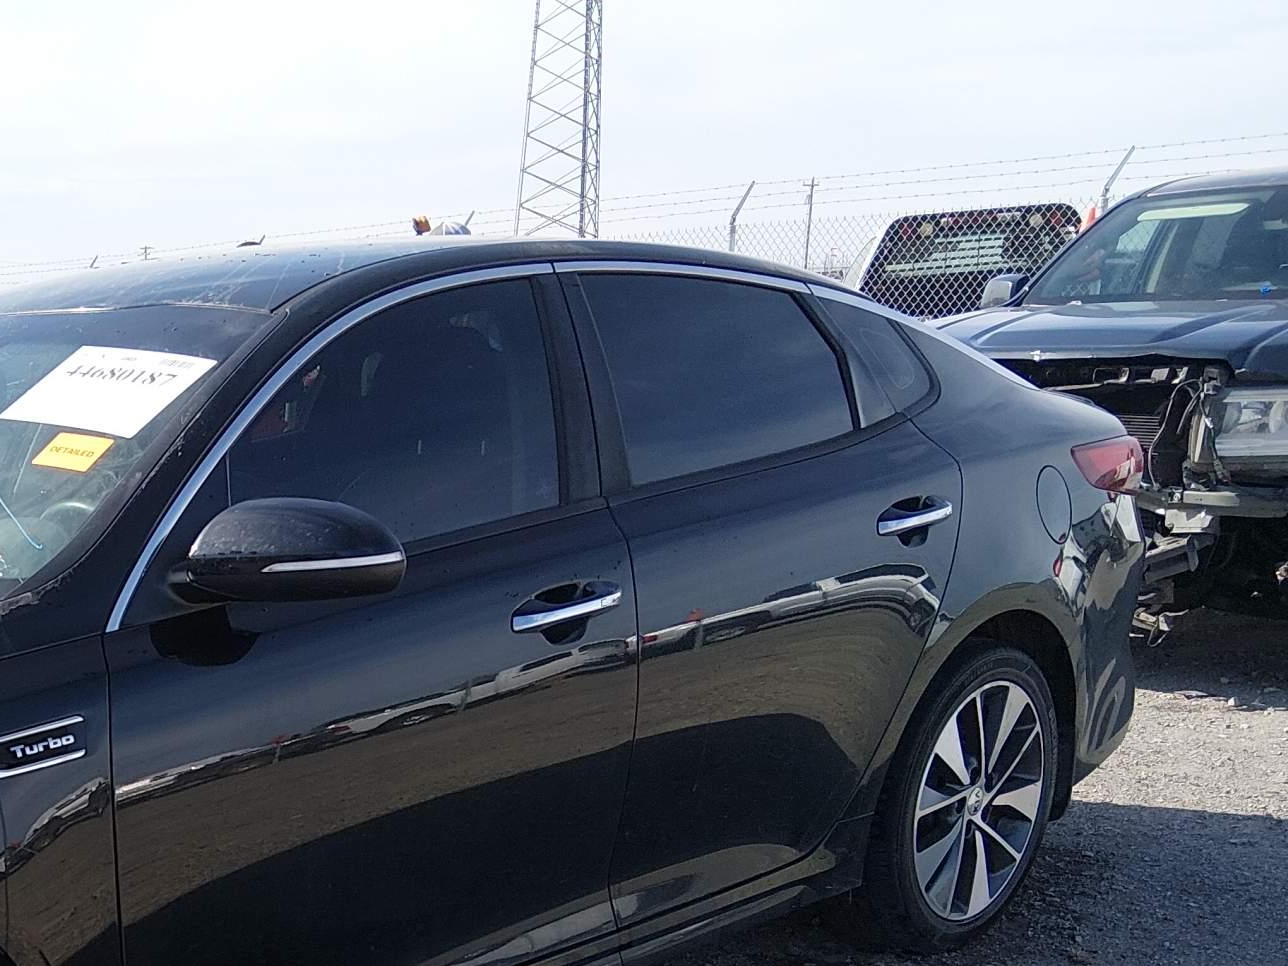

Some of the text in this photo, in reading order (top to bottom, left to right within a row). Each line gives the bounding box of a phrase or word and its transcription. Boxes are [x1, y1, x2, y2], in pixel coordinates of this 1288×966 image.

[66, 365, 178, 385] 44680187
[50, 446, 94, 457] DETAILED
[10, 735, 75, 758] Turbo
